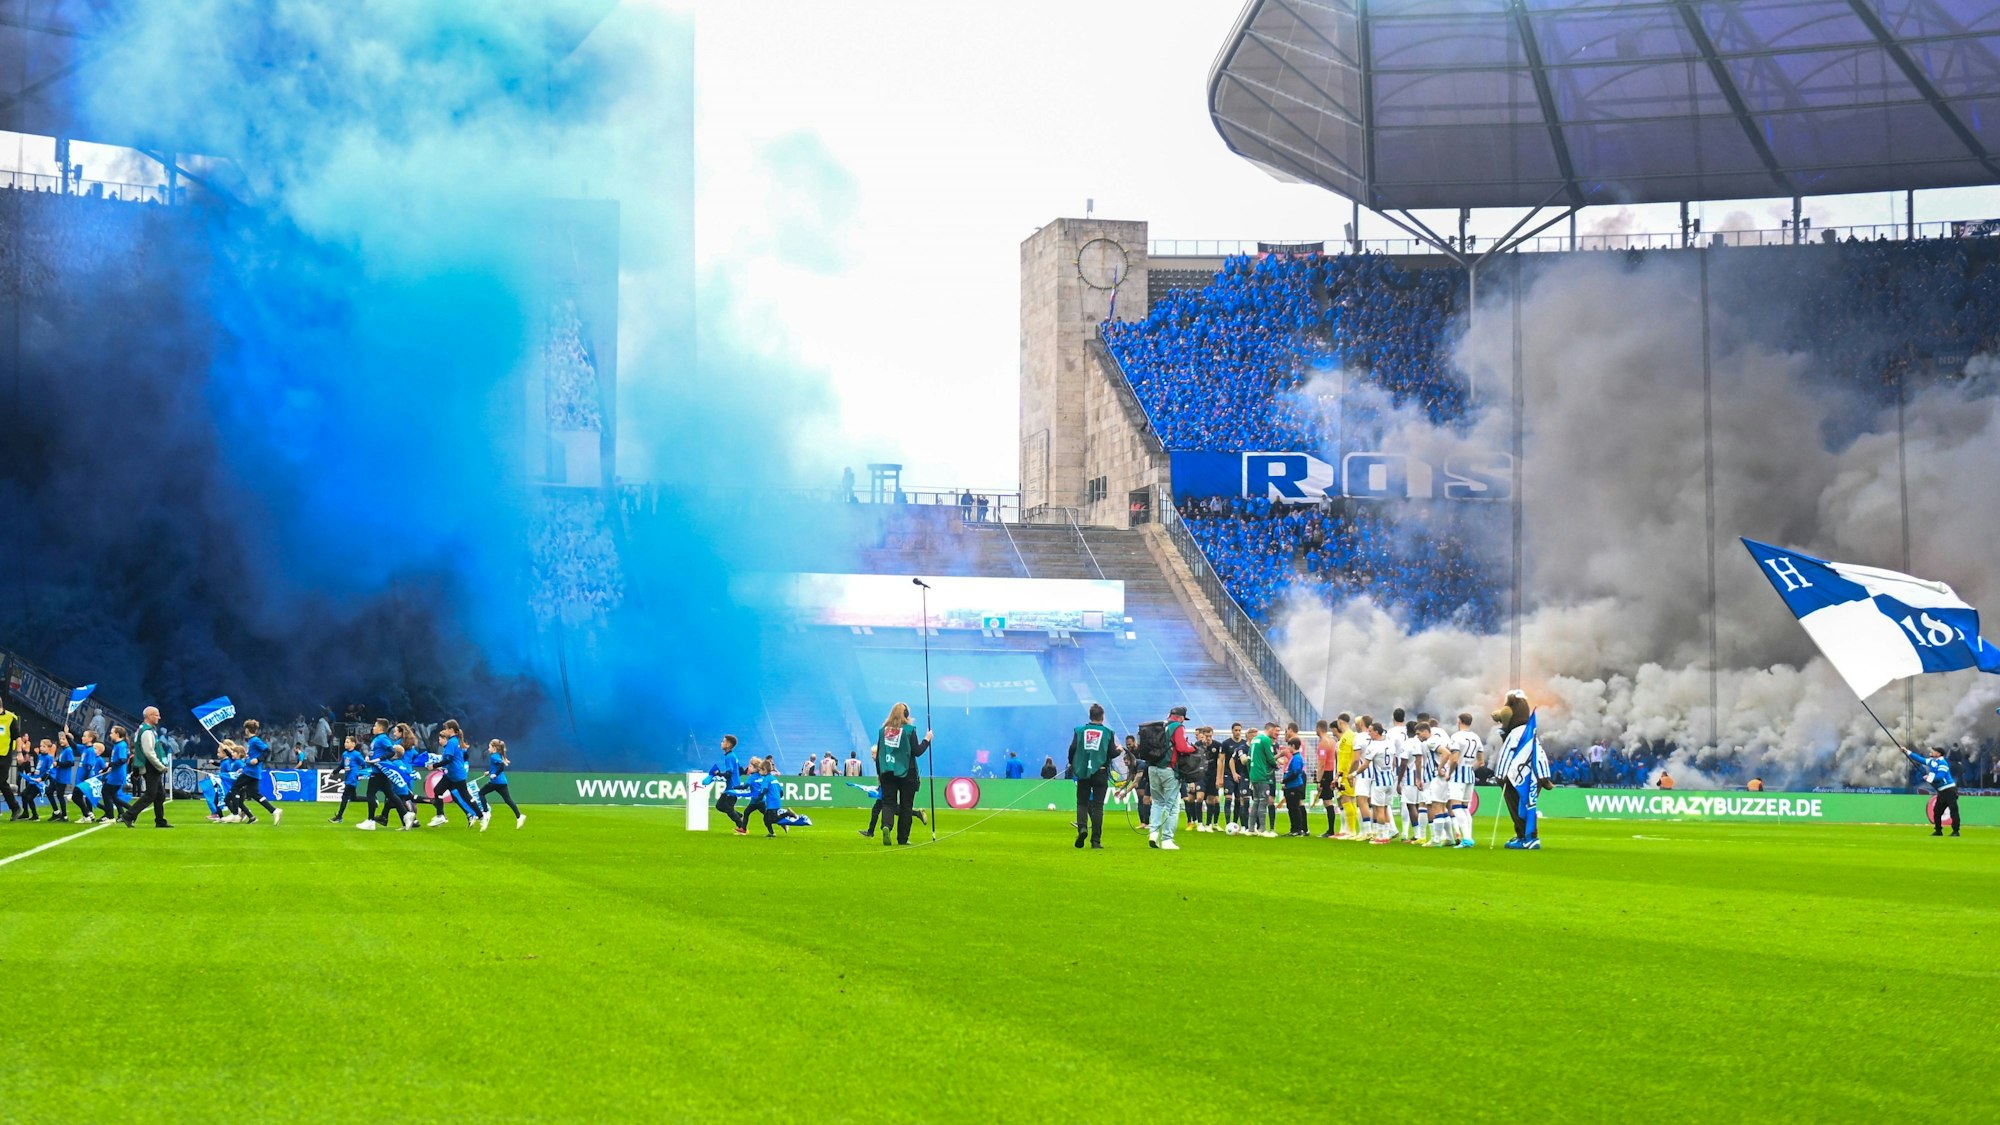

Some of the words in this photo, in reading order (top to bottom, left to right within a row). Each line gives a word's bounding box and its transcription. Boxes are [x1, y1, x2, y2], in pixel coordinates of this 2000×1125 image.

[1764, 557, 1813, 592] H
[1384, 747, 1391, 766] 6
[952, 781, 973, 806] B
[1585, 795, 1824, 817] WWW.CRAZYBUZZER.DE
